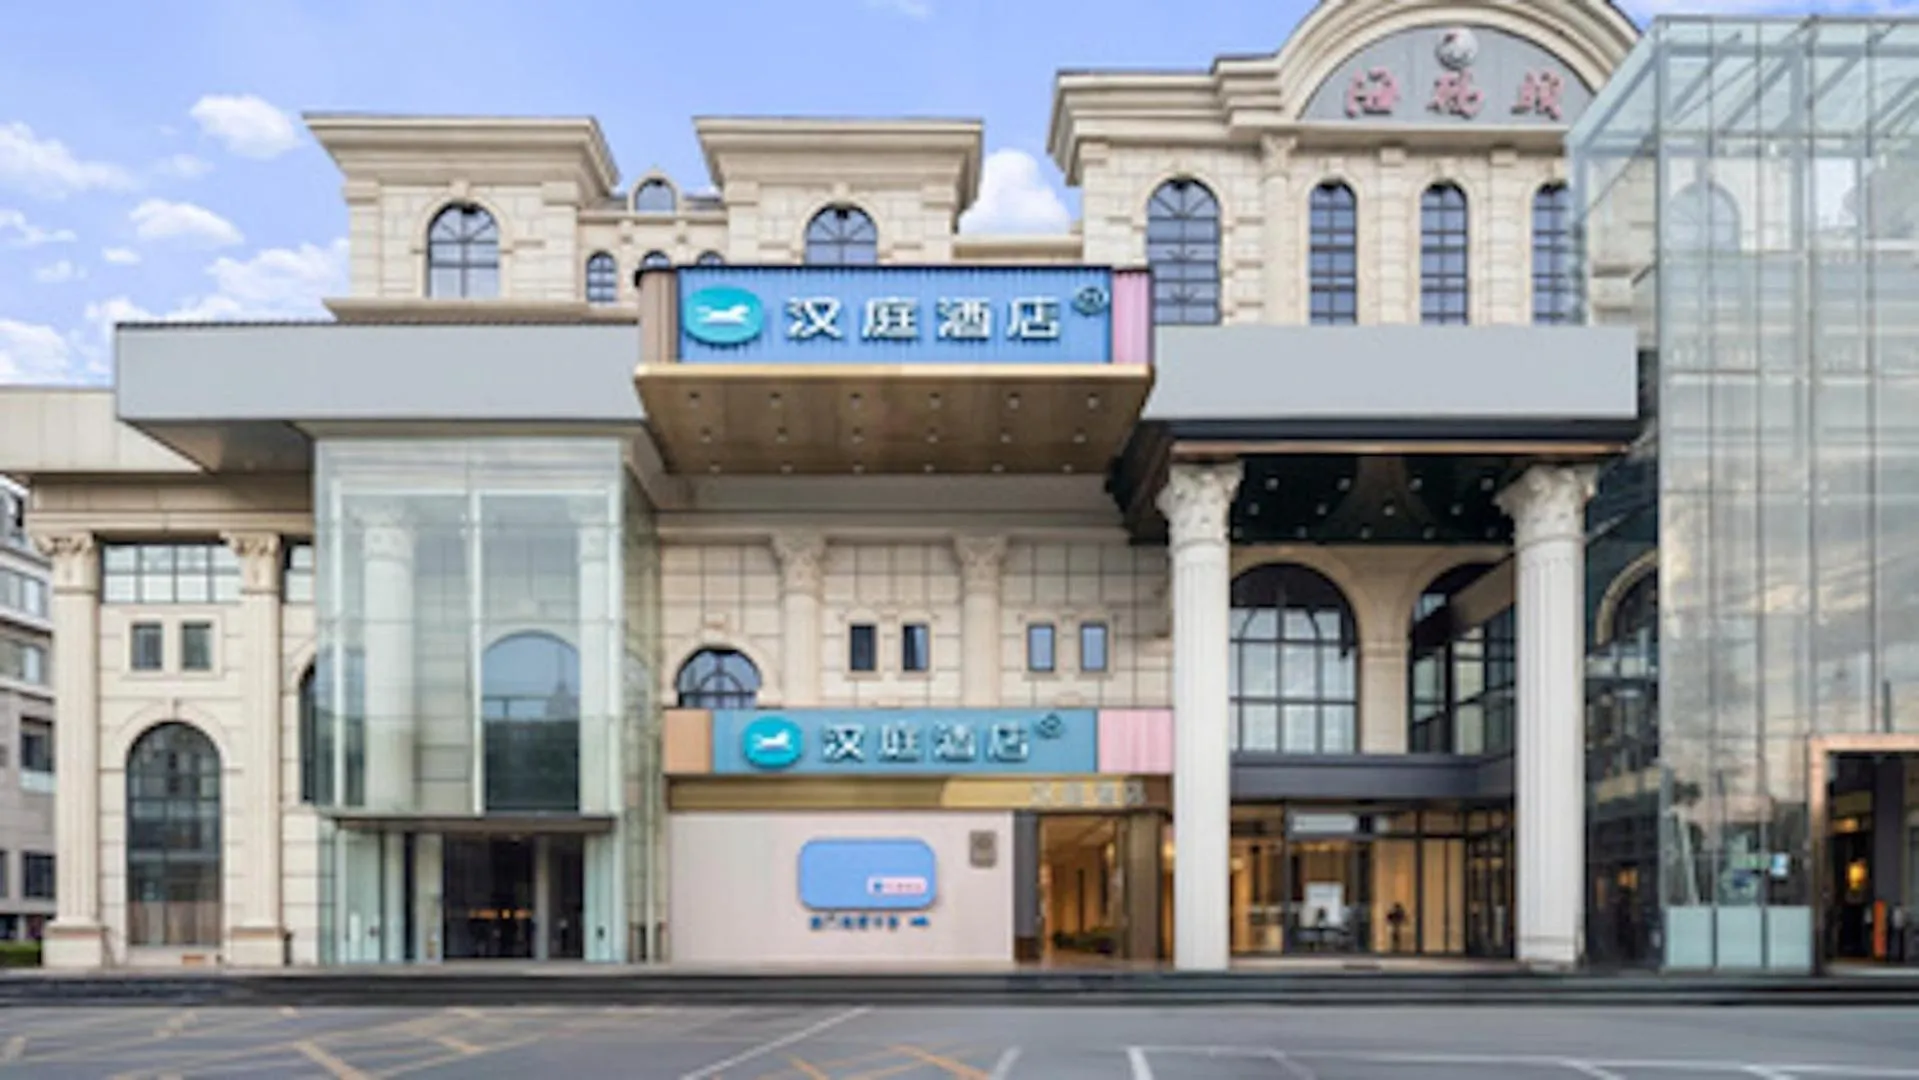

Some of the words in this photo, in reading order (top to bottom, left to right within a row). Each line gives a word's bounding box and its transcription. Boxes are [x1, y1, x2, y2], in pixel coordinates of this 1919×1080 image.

[785, 295, 1061, 341] 汉庭酒店
[822, 723, 1030, 765] 汉庭酒店
